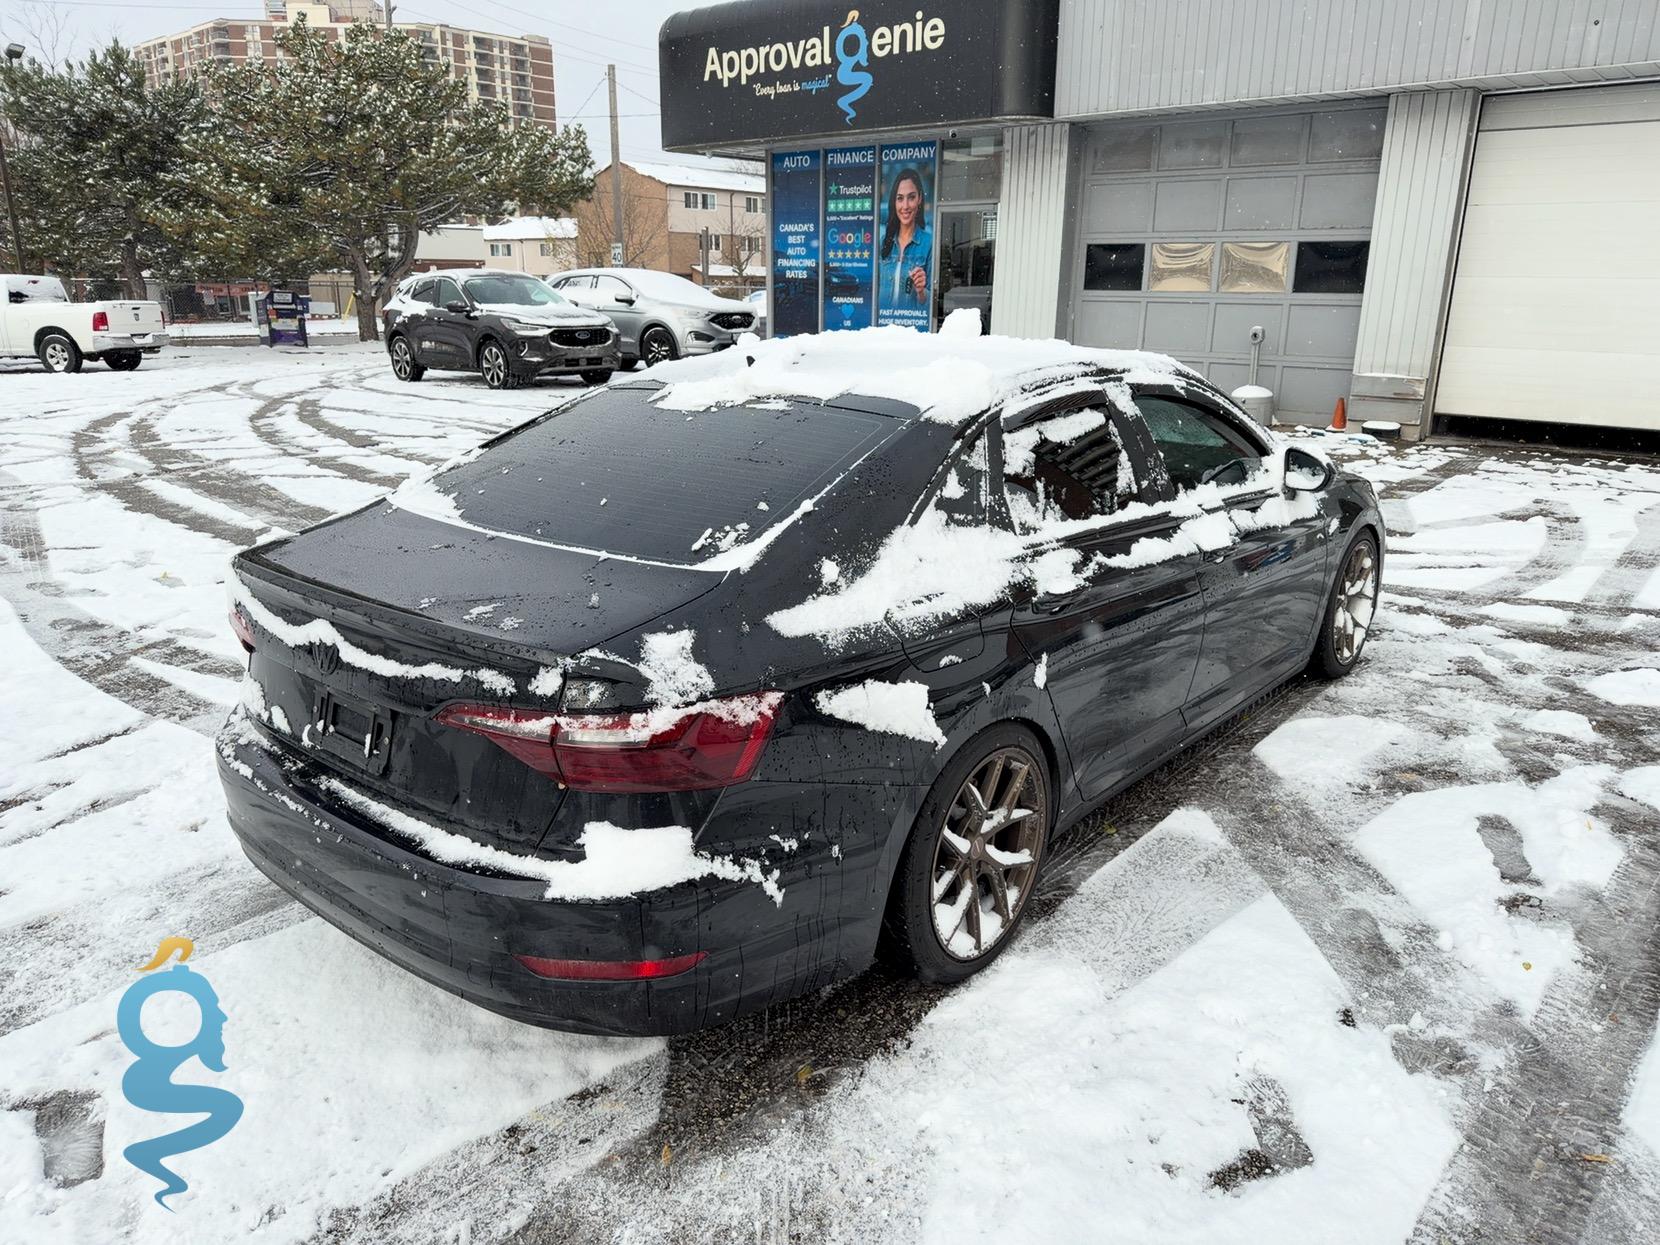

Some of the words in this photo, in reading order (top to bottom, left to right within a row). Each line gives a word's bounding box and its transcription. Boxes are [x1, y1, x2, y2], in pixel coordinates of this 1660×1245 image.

[703, 26, 832, 87] Approval
[776, 81, 792, 94] loan
[793, 80, 801, 91] is
[783, 155, 810, 168] AUTO
[827, 150, 874, 165] FINANCE
[882, 146, 936, 161] COMPANY
[839, 184, 872, 195] Trustpilot
[779, 223, 815, 232] CANADA'S
[787, 234, 805, 244] BEST
[828, 227, 872, 248] Google
[786, 247, 806, 256] AUTO
[612, 252, 622, 263] 40
[777, 258, 816, 267] FINANCING
[785, 269, 808, 279] RATES
[832, 296, 864, 304] CANADIANS
[843, 319, 852, 327] US
